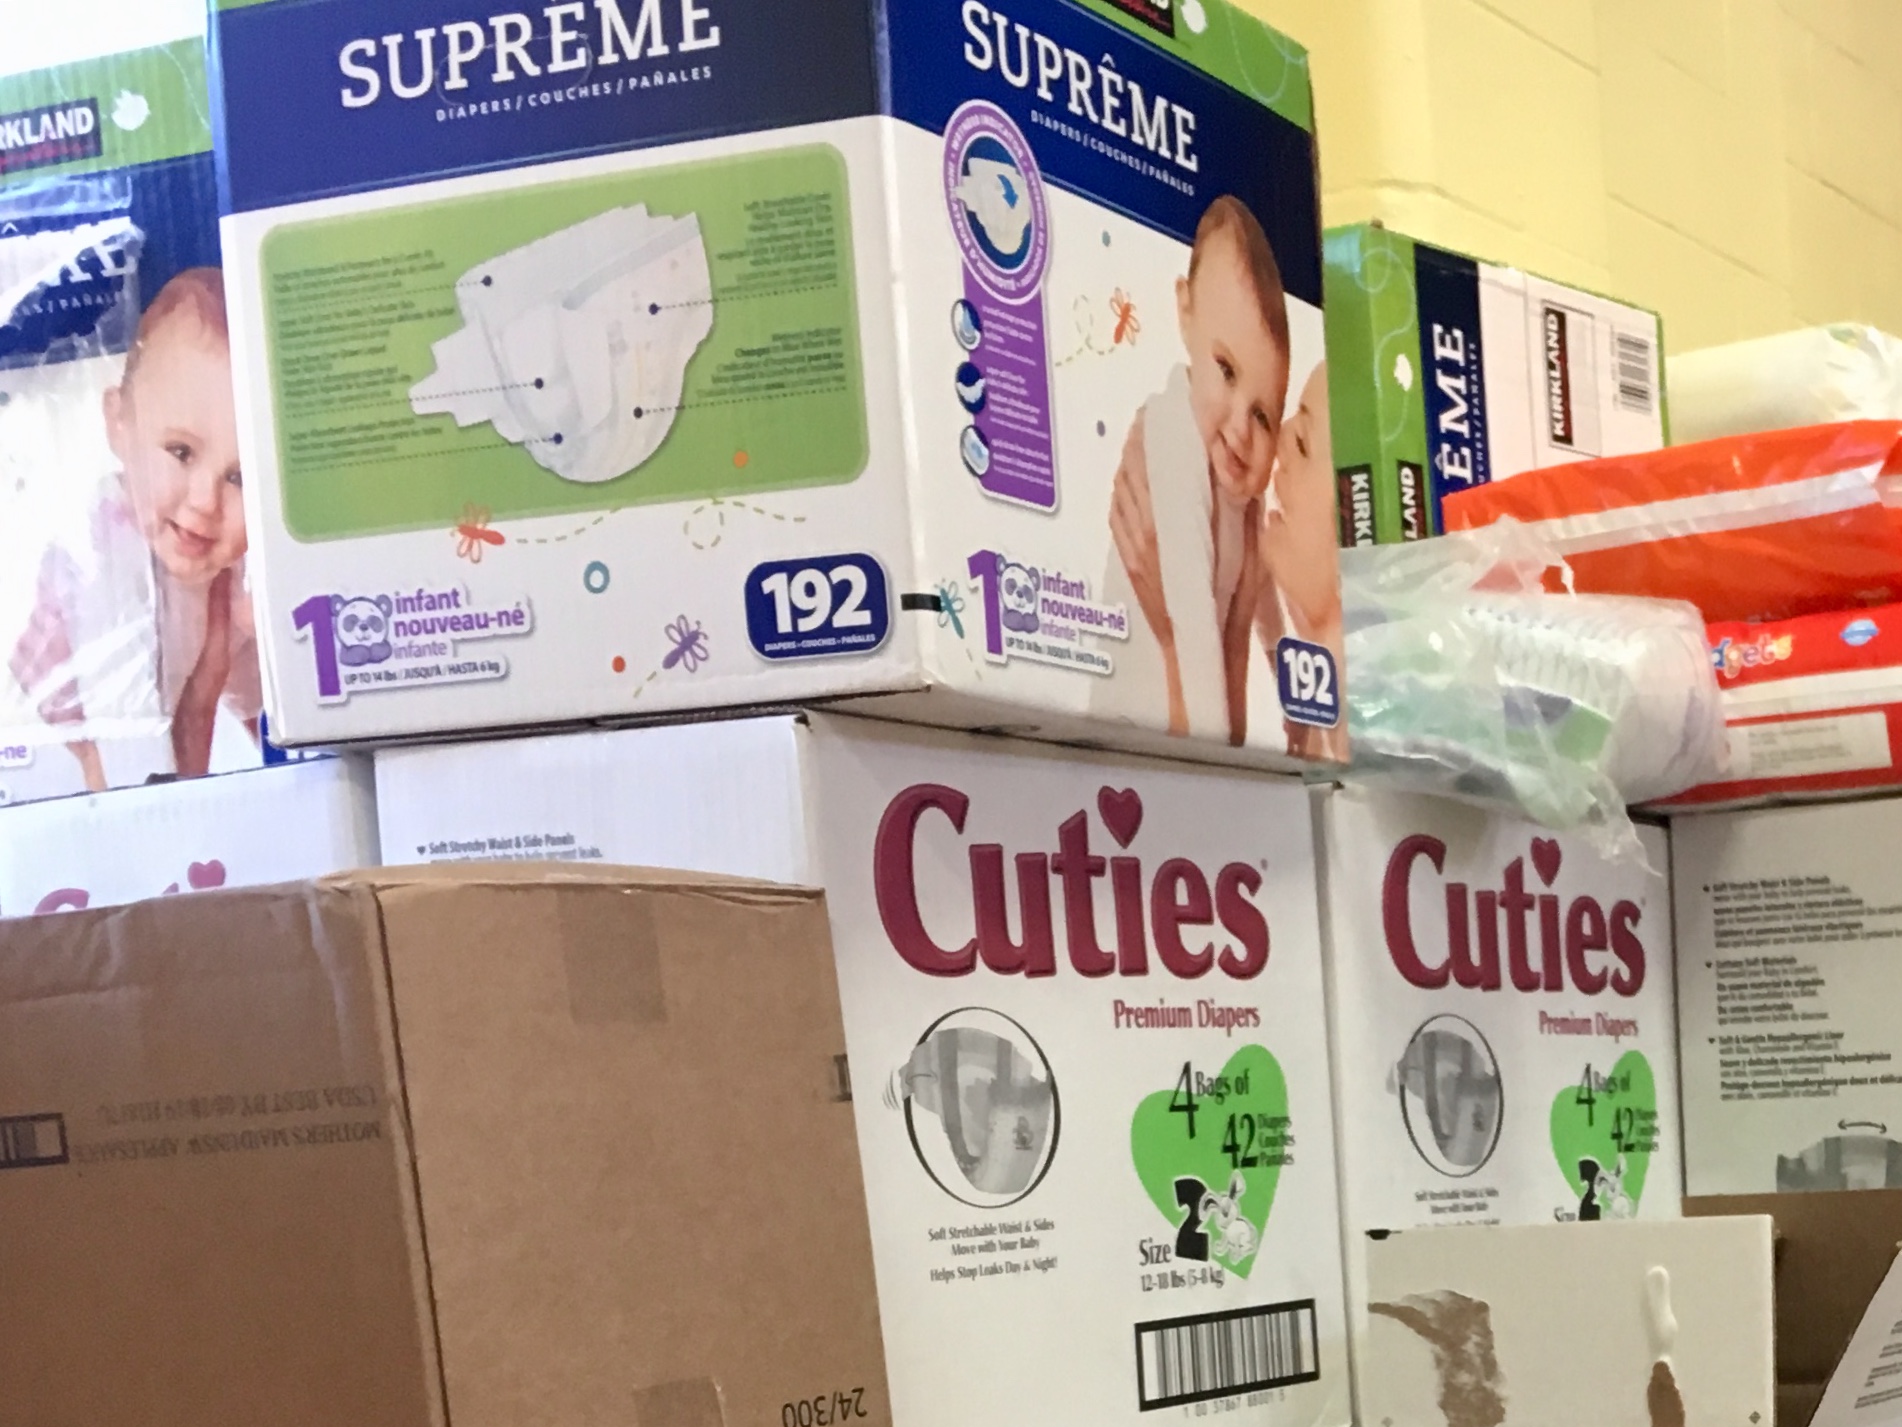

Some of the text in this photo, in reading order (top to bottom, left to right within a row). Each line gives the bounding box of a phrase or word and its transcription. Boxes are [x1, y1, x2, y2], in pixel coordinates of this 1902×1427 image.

[962, 0, 1198, 172] SUPRÊME
[1546, 313, 1566, 437] KIRKLAND
[395, 587, 461, 615] infant
[761, 564, 872, 634] 192
[1041, 568, 1086, 600] infant
[394, 602, 525, 637] nouveau-né
[1041, 598, 1125, 631] nouveau-né
[394, 639, 447, 660] infante
[1283, 648, 1333, 706] 192
[874, 783, 1269, 980] Cuties
[1382, 834, 1646, 998] Cuties
[1113, 998, 1261, 1037] Premium Diapers
[1169, 1061, 1250, 1140] 4 Bags of
[1576, 1063, 1596, 1127] 4
[1221, 1113, 1258, 1169] 42
[1611, 1107, 1635, 1153] 42
[928, 1227, 946, 1241] Soft
[1034, 1218, 1055, 1231] Sides
[1139, 1178, 1209, 1266] Size 2
[930, 1268, 955, 1284] Helps
[957, 1266, 977, 1281] Stop
[979, 1262, 1004, 1277] Leaks
[951, 1244, 976, 1256] Move
